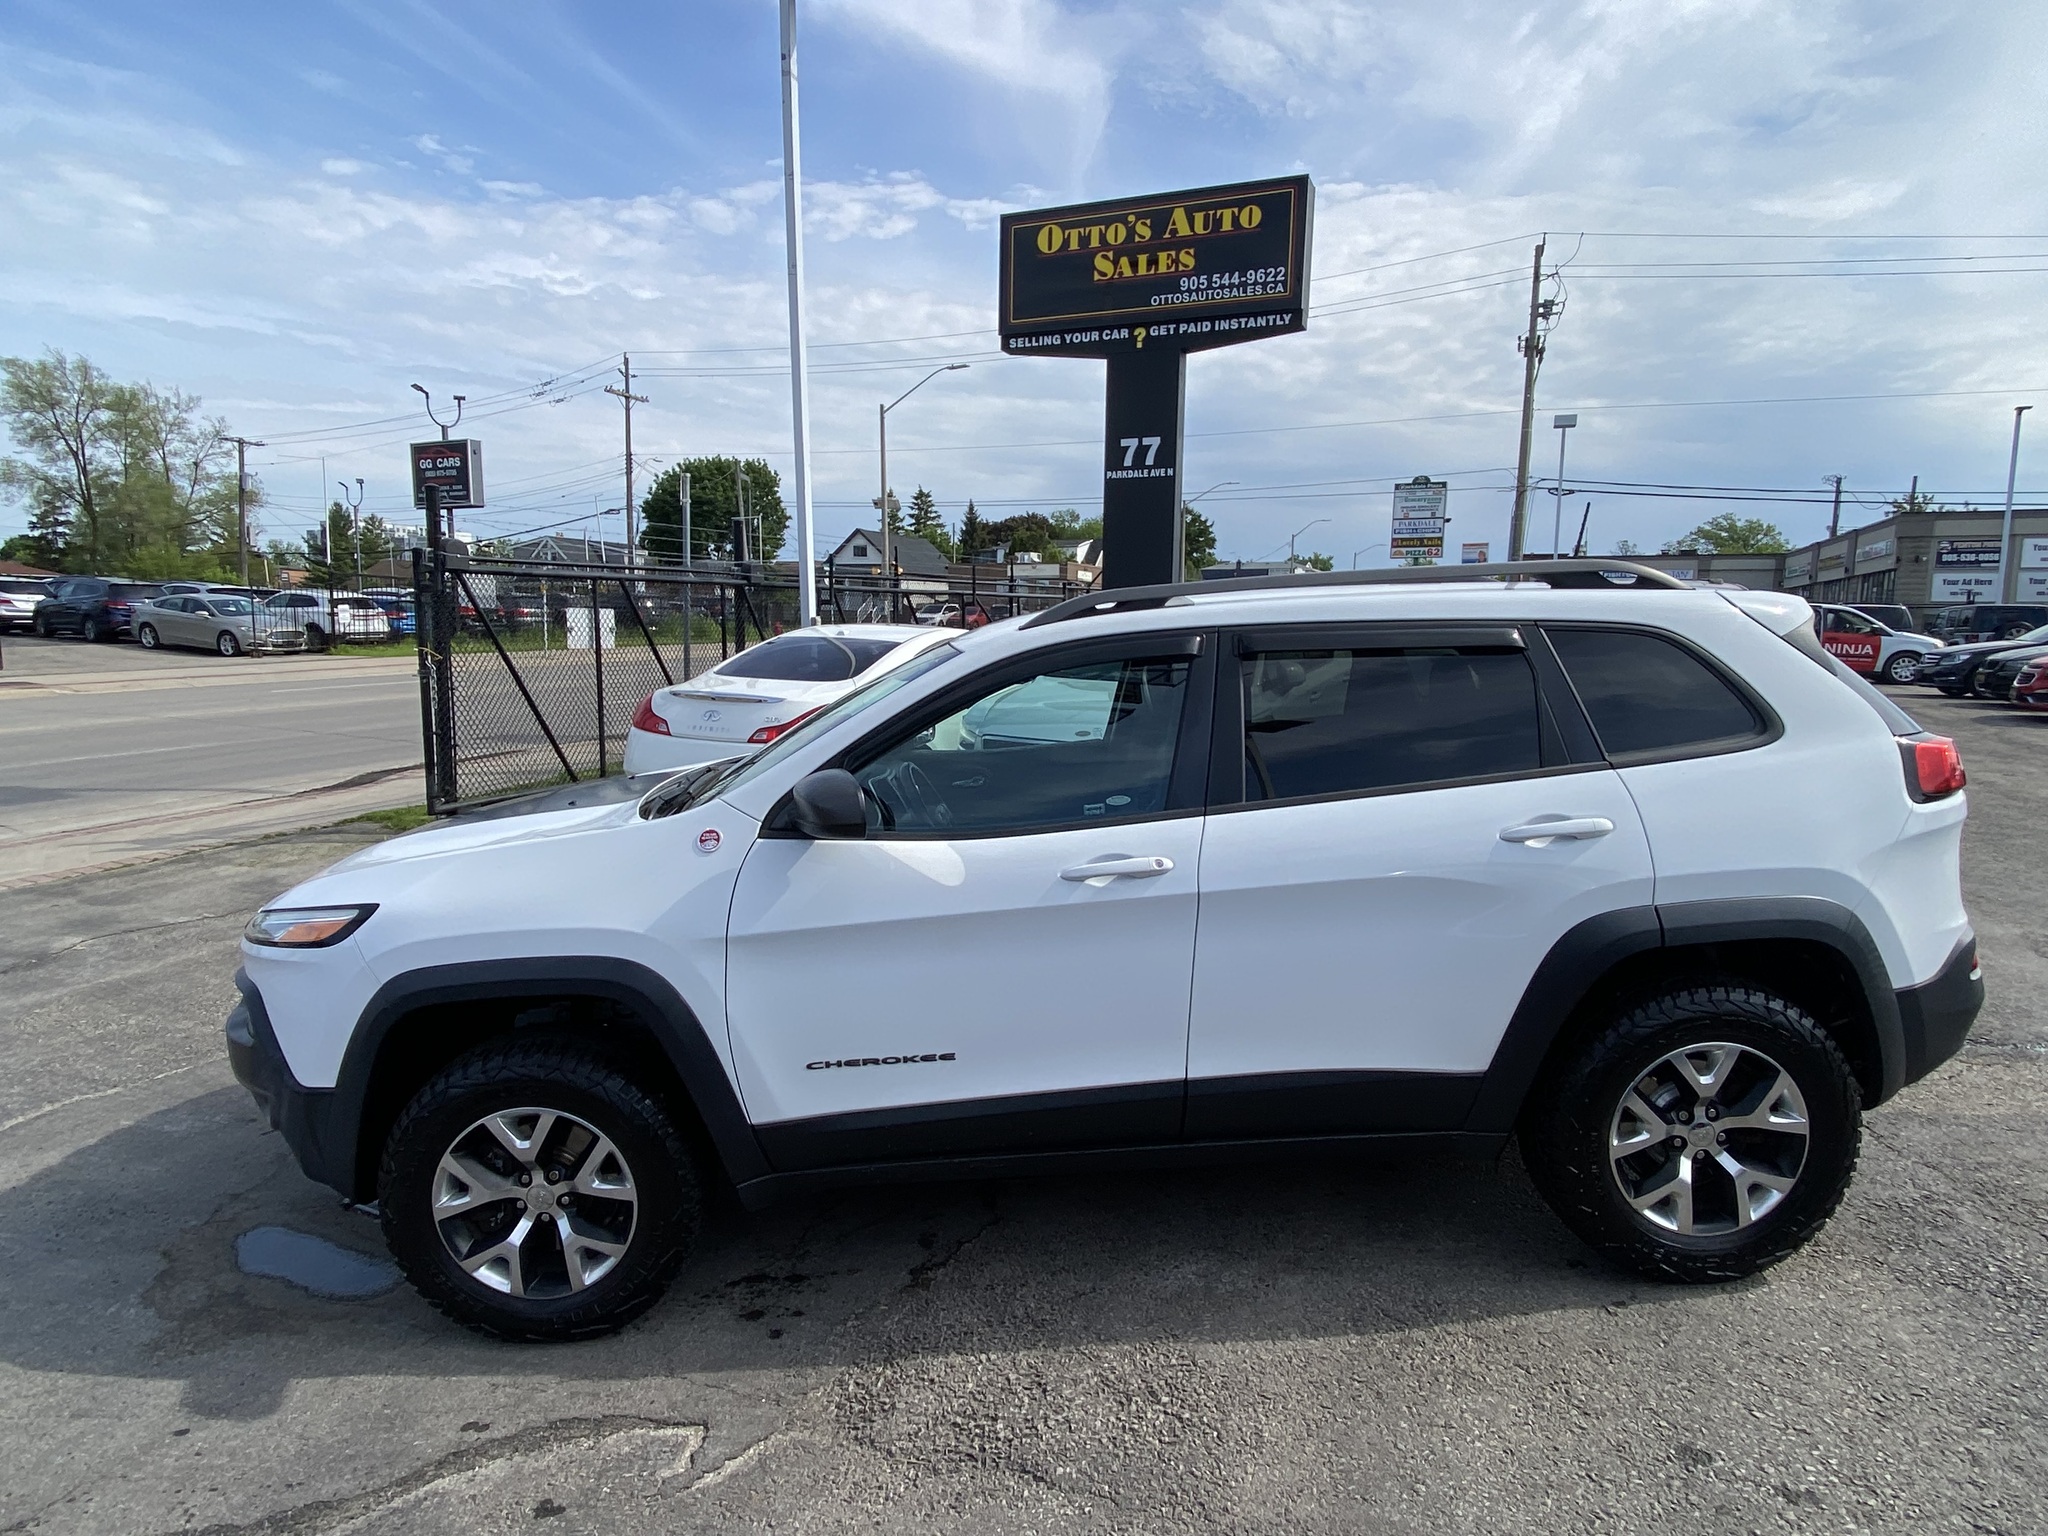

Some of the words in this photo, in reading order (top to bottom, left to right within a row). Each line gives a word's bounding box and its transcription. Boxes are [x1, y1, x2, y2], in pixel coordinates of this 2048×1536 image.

[1037, 214, 1152, 255] OTTO'S
[1163, 205, 1262, 239] AUTO
[1093, 248, 1196, 281] SALES
[1180, 275, 1208, 291] 905
[1211, 267, 1286, 287] 544-9622
[1150, 283, 1285, 306] OTTOSAUTOSALES.CA
[1009, 334, 1062, 349] SELLING
[1064, 331, 1100, 344] YOUR
[1102, 328, 1130, 341] CAR
[1150, 323, 1177, 337] GET
[1179, 320, 1212, 335] PAID
[1214, 313, 1292, 332] INSTANTLY
[420, 459, 433, 469] GG
[436, 457, 461, 468] CARS
[1120, 436, 1161, 467] 77
[1106, 469, 1149, 479] PARKDALE
[1150, 468, 1166, 477] AVE
[1167, 467, 1174, 476] N
[1942, 578, 1960, 586] Your
[1824, 643, 1873, 655] NINJA
[806, 1052, 956, 1070] CHEROKEE
